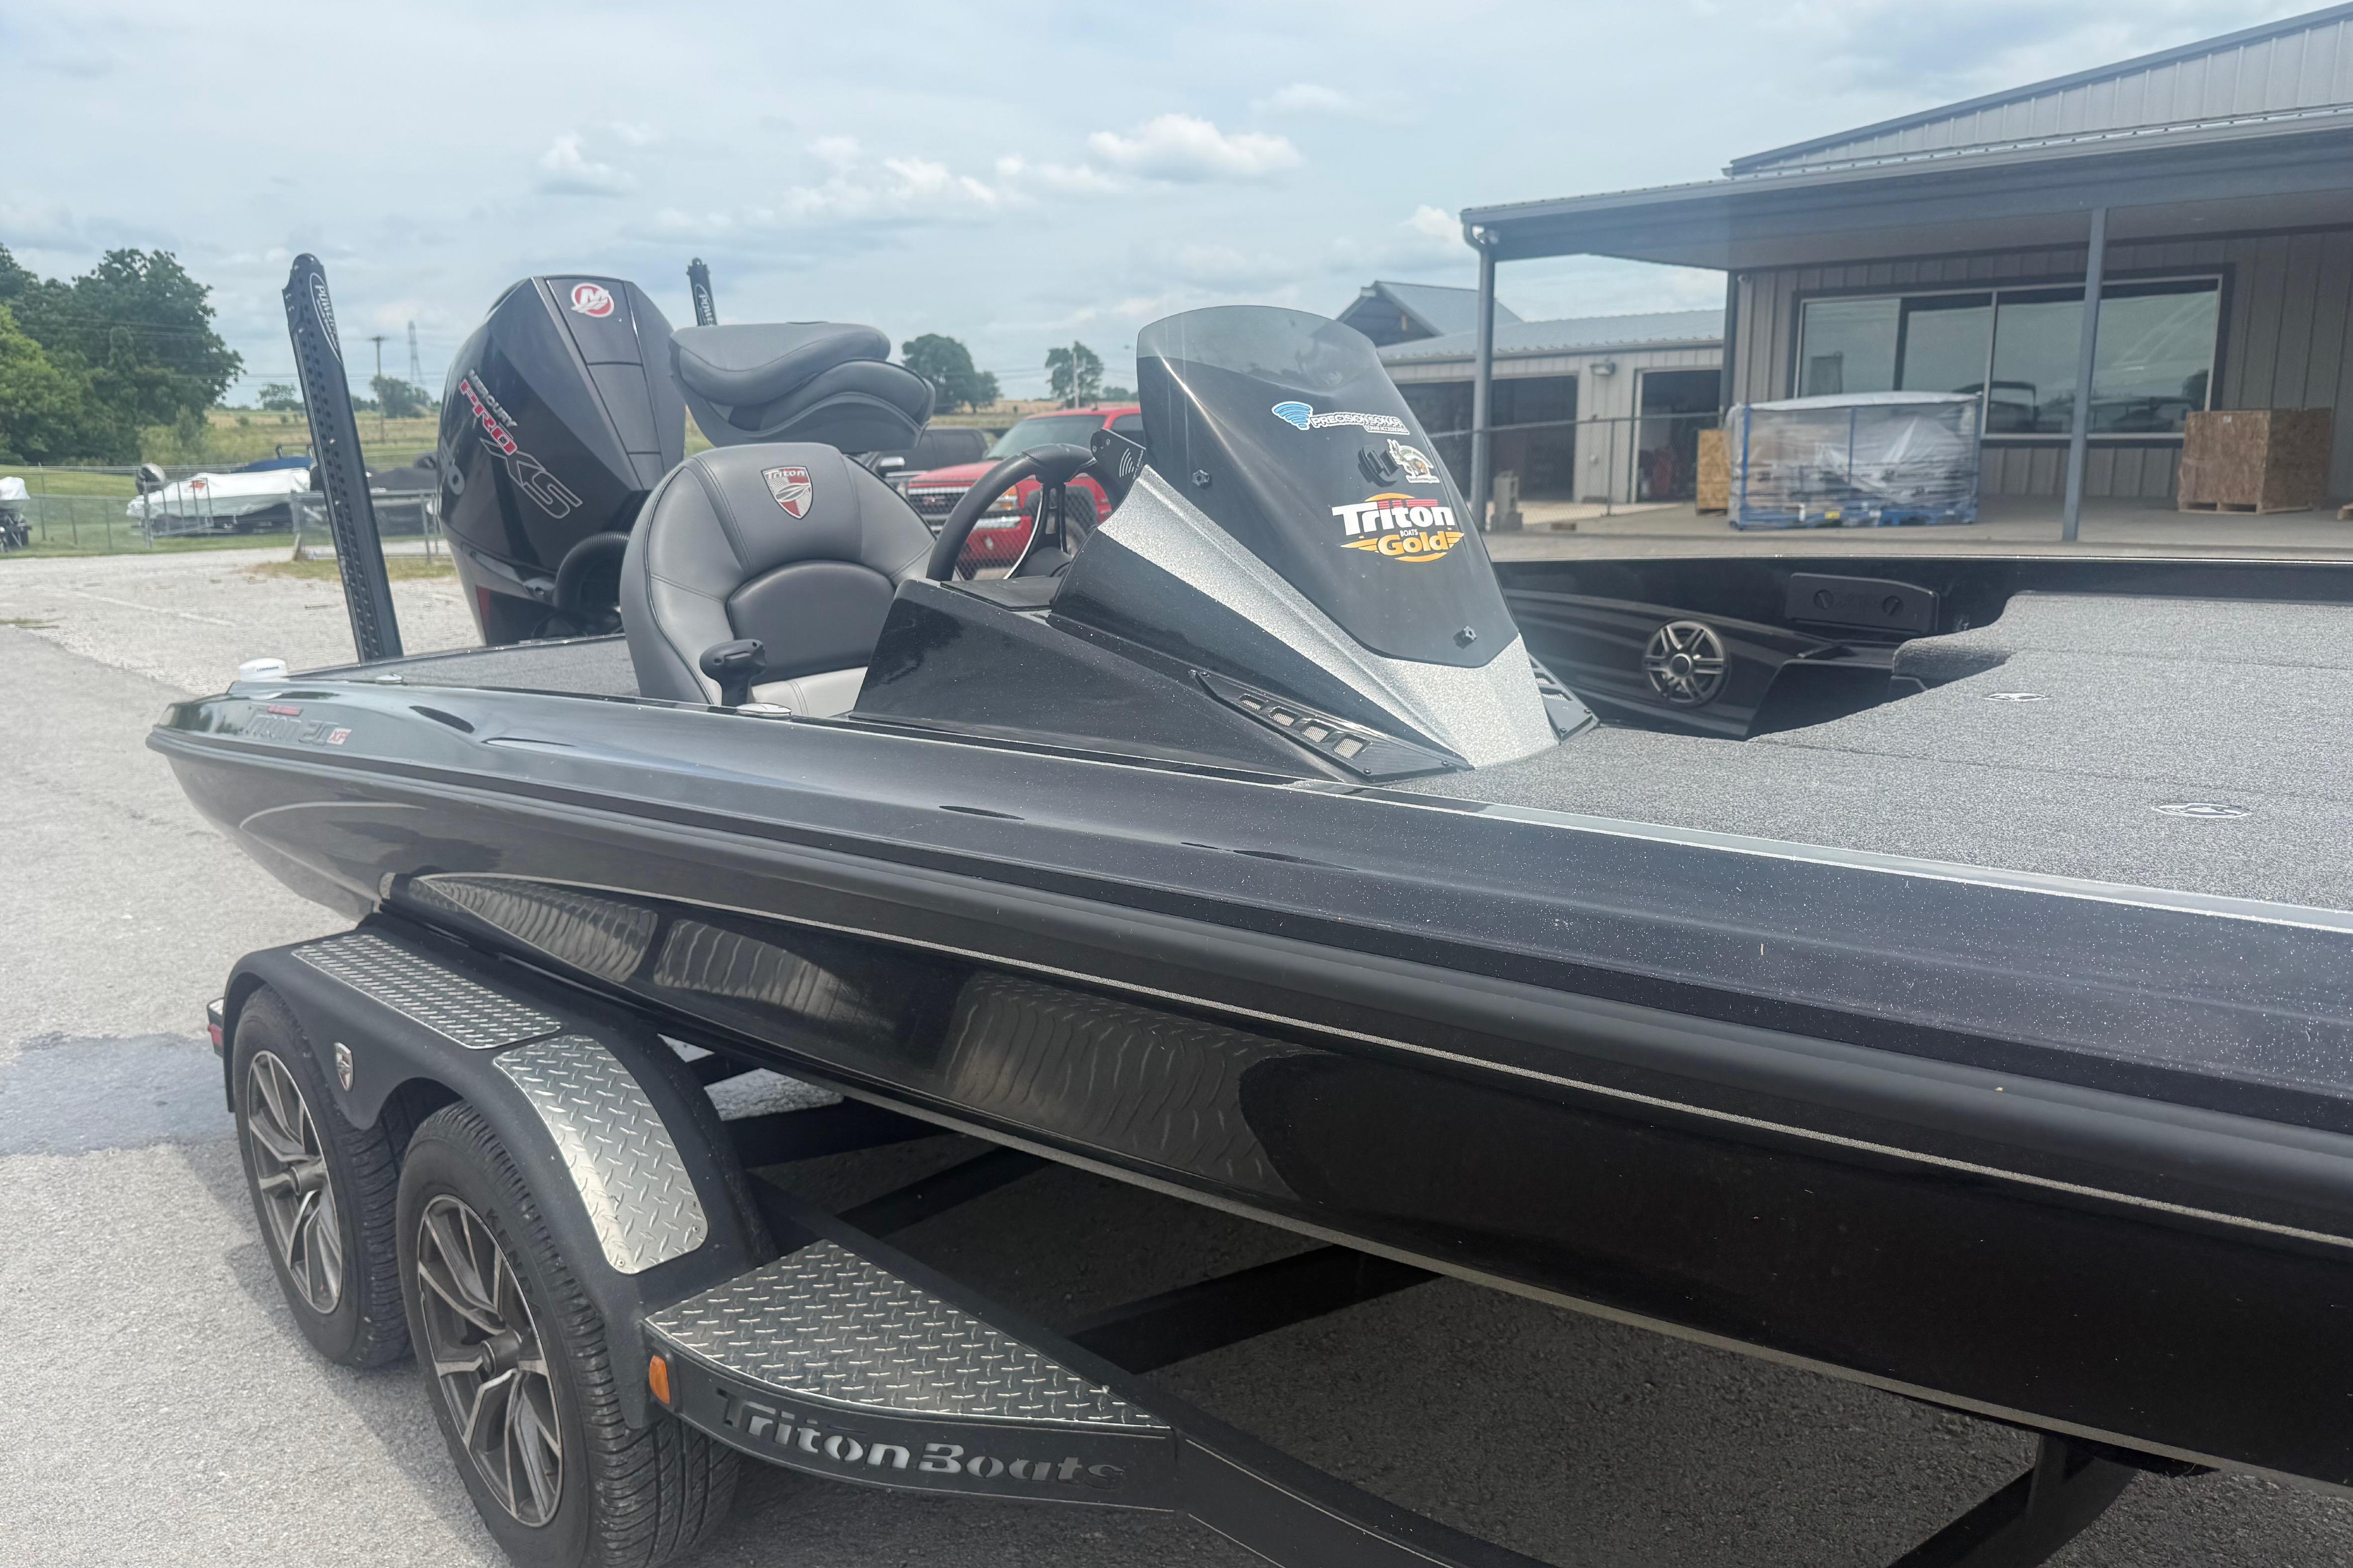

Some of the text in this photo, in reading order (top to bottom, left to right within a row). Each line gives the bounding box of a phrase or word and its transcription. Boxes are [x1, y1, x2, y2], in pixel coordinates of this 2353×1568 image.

[469, 369, 518, 427] MERCURY
[1310, 413, 1402, 426] PRECISION SONAR
[460, 379, 583, 519] PRO XS
[765, 469, 806, 480] Triton
[1331, 499, 1455, 536] Triton
[1378, 531, 1449, 556] Gold
[486, 1207, 543, 1319] KENDA
